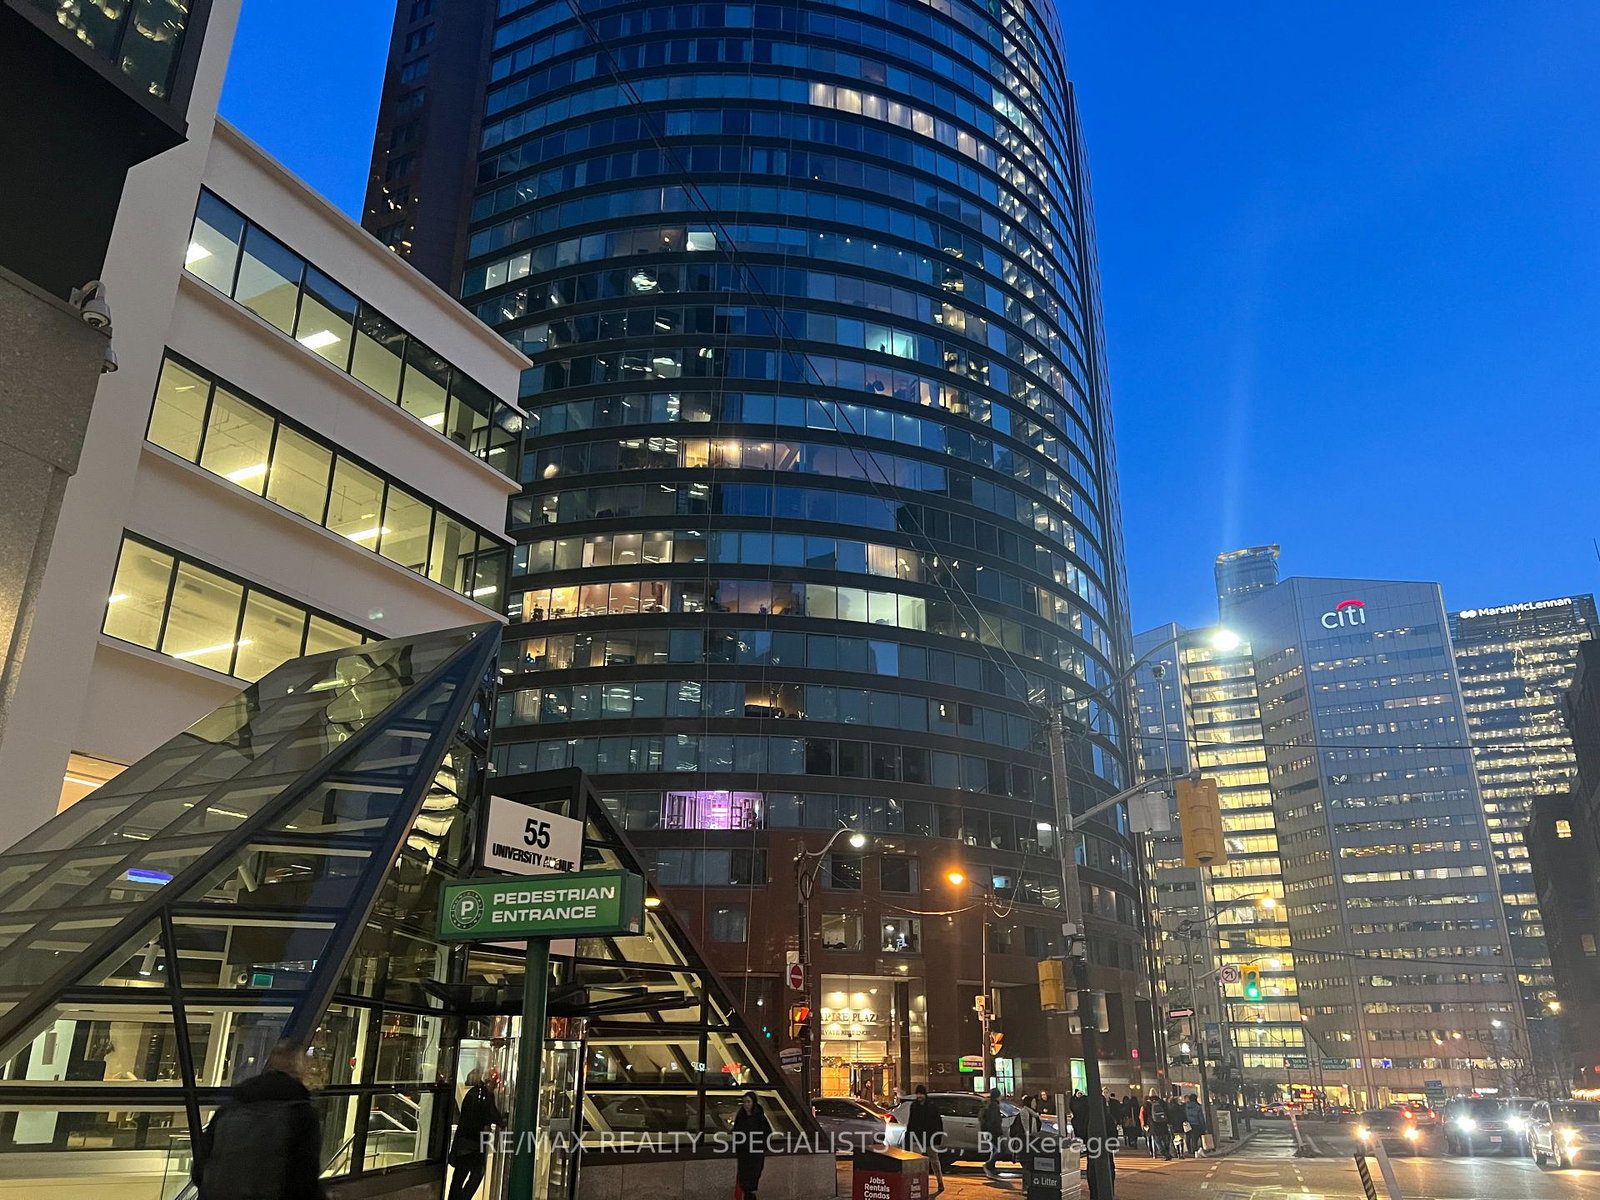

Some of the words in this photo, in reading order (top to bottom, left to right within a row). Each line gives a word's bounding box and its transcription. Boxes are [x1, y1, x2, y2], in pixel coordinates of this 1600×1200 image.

[1321, 605, 1366, 629] citi
[524, 818, 550, 849] 55
[492, 842, 542, 866] UNIVERSITY
[493, 886, 615, 905] PEDESTRIAN
[492, 905, 597, 923] ENTRANCE
[821, 1012, 849, 1022] PIRE
[864, 1183, 890, 1193] Rentals
[869, 1177, 886, 1185] Jobs
[1041, 1176, 1057, 1186] Litter
[864, 1190, 890, 1200] Condos
